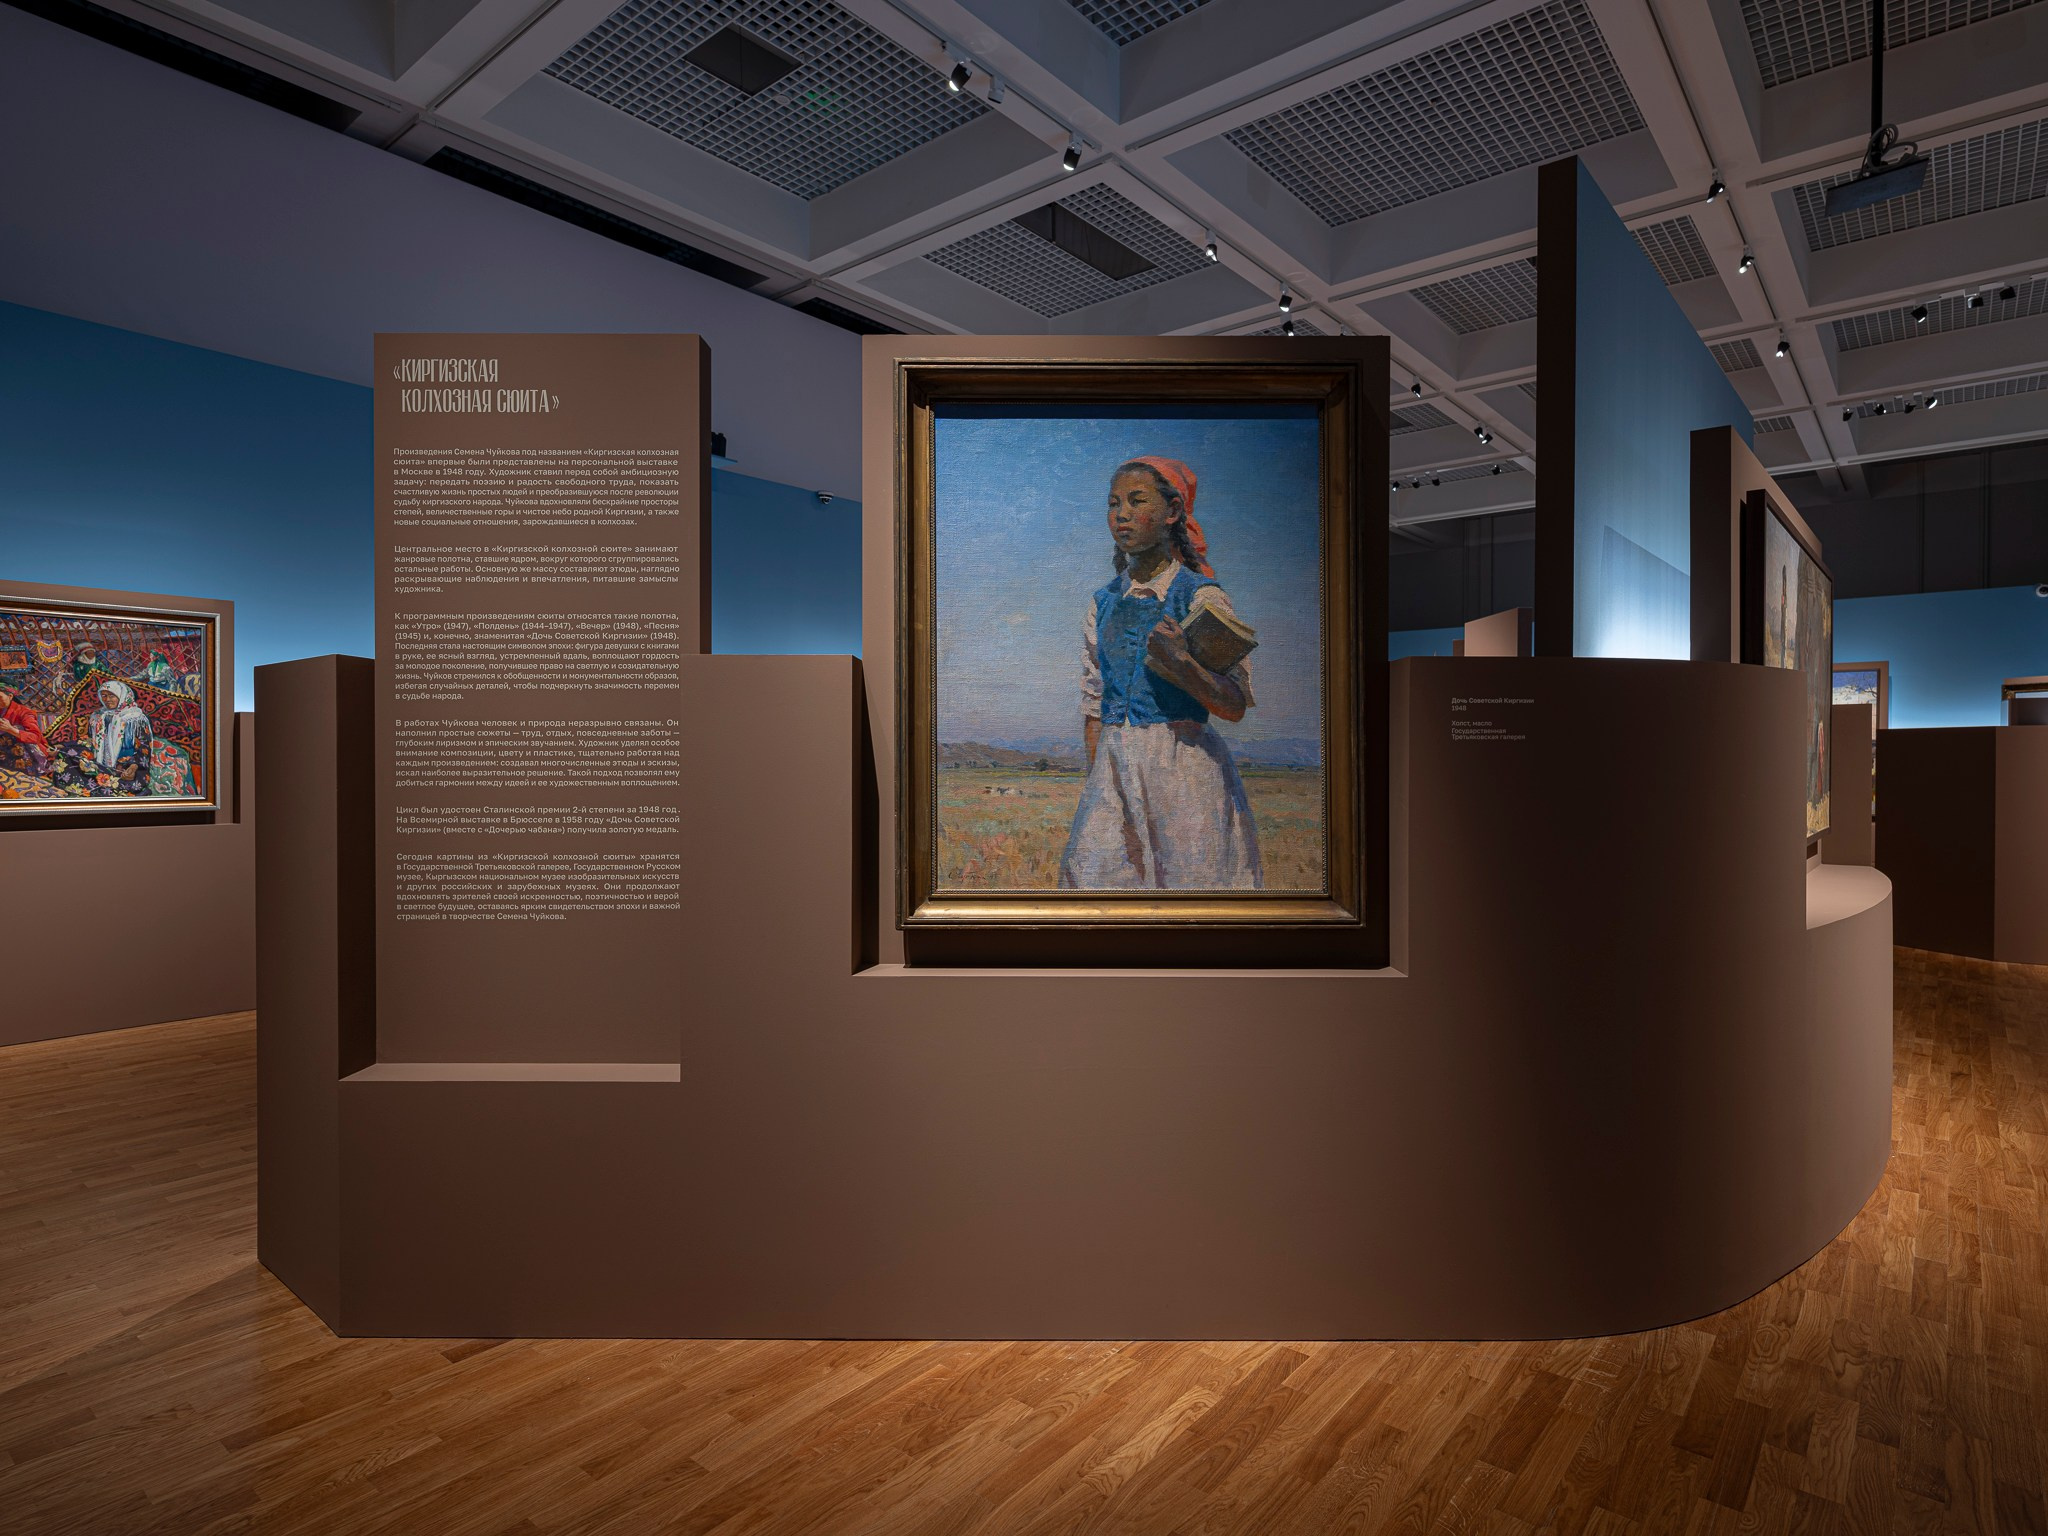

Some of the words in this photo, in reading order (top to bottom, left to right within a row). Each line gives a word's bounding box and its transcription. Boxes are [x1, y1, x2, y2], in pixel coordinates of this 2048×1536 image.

[393, 359, 498, 382] «КИРГИЗСКАЯ
[401, 389, 491, 412] КОЛХОЗНАЯ
[497, 389, 560, 412] СЮИТА»
[393, 448, 453, 457] Произведения
[486, 448, 520, 457] Чуйкова
[583, 448, 635, 457] «Киргизская
[427, 459, 466, 467] впервые
[492, 459, 556, 467] представлены
[571, 458, 635, 467] персональной
[393, 498, 421, 507] судьбу
[422, 499, 471, 507] киргизского
[472, 499, 504, 507] народа.
[505, 498, 538, 507] Чуйкова
[592, 498, 640, 507] бескрайние
[641, 499, 679, 507] просторы
[522, 519, 589, 527] зарождавшиеся
[394, 545, 453, 554] Центральное
[491, 544, 549, 554] «Киргизской
[551, 544, 598, 552] колхозной
[394, 556, 436, 564] жанровые
[510, 556, 539, 564] ядром,
[540, 556, 569, 564] вокруг
[569, 556, 607, 564] которого
[608, 556, 680, 564] сгруппировались
[394, 576, 462, 584] раскрывающие
[465, 575, 520, 583] наблюдения
[394, 586, 444, 594] художника.
[403, 613, 464, 621] программным
[466, 613, 535, 621] произведениям
[394, 632, 421, 640] (1945)
[526, 632, 553, 640] «Дочь
[554, 631, 600, 639] Советской
[602, 632, 648, 641] Киргизии»
[650, 632, 680, 640] (1948).
[394, 642, 438, 650] Последняя
[574, 641, 604, 651] фигура
[429, 681, 474, 691] случайных
[475, 681, 511, 690] деталей,
[402, 692, 431, 701] судьбе
[432, 693, 464, 701] народа.
[395, 739, 434, 748] глубоким
[435, 740, 477, 748] лиризмом
[578, 739, 619, 747] Художник
[650, 738, 680, 746] особое
[395, 779, 434, 787] добиться
[504, 778, 530, 787] идеей
[396, 826, 441, 835] Киргизии»
[443, 826, 476, 834] (вместе
[484, 826, 527, 834] «Дочерью
[528, 825, 565, 834] чабана»)
[396, 853, 433, 861] Сегодня
[492, 852, 549, 861] «Киргизской
[553, 852, 599, 860] колхозной
[403, 862, 474, 871] Государственной
[475, 862, 536, 871] Третьяковской
[573, 862, 645, 871] Государственном
[646, 862, 681, 871] Русском
[396, 874, 424, 882] музее,
[426, 873, 477, 881] Кыргызском
[568, 872, 640, 881] изобразительных
[396, 912, 440, 922] страницей
[497, 912, 528, 920] Семена
[529, 912, 567, 921] Чуйкова.
